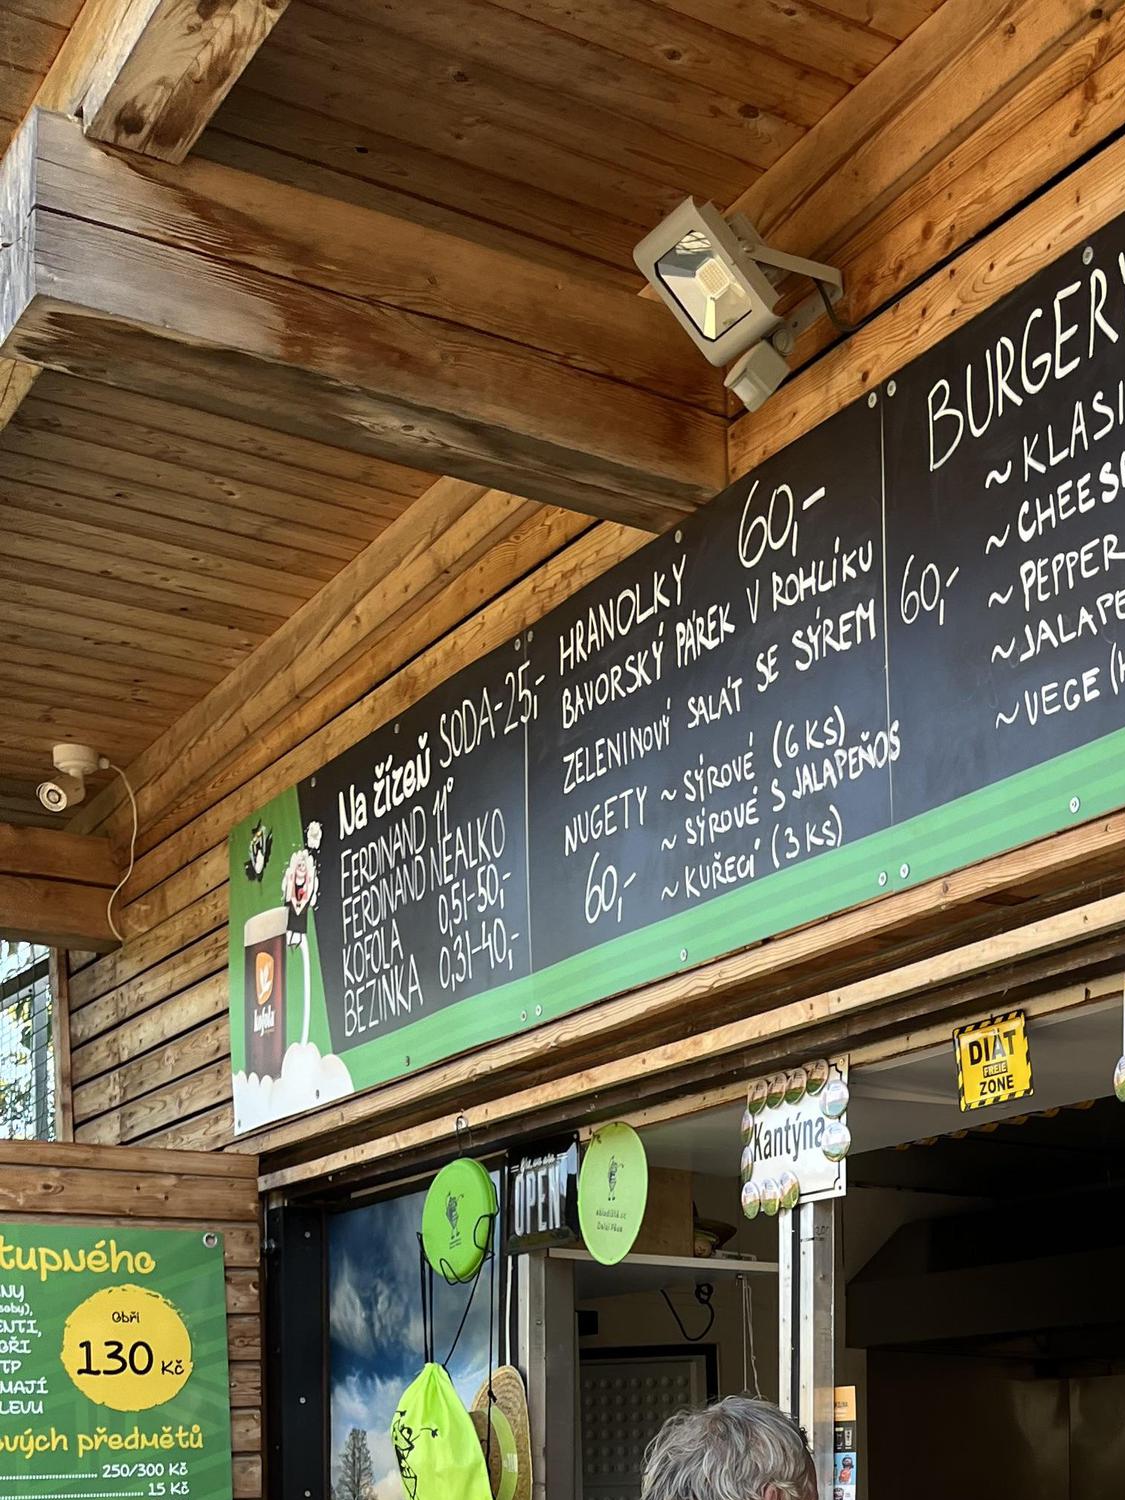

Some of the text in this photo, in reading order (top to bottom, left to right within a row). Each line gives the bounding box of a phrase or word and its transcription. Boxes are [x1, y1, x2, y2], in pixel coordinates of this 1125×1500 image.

[559, 555, 687, 676] HRANOLKY
[562, 537, 873, 729] BAVORSKÝ PÁREK V ROHLÍKU
[563, 598, 876, 794] ZELENINOVÝ SALÁT SE SÝREM
[1025, 667, 1101, 725] VEGE
[339, 784, 368, 840] Na
[564, 786, 647, 856] NUGETY
[683, 732, 756, 801] SÝROVÉ
[686, 785, 759, 846] SÝROVÉ
[772, 784, 786, 812] S
[341, 804, 427, 897] FERDINAND
[343, 808, 505, 944] FERDINAND NEALKO
[685, 838, 760, 898] KUŘECÍ
[343, 919, 403, 989] KOFOLA
[345, 954, 423, 1037] BEZINKA
[980, 1074, 1014, 1096] ZONE
[983, 1061, 1007, 1076] FREIE
[754, 1112, 825, 1162] Kantýna
[515, 1164, 560, 1237] OPEN
[77, 1341, 184, 1376] 130 Kč
[102, 1462, 188, 1479] 250/300 Kč
[148, 1483, 166, 1496] 15
